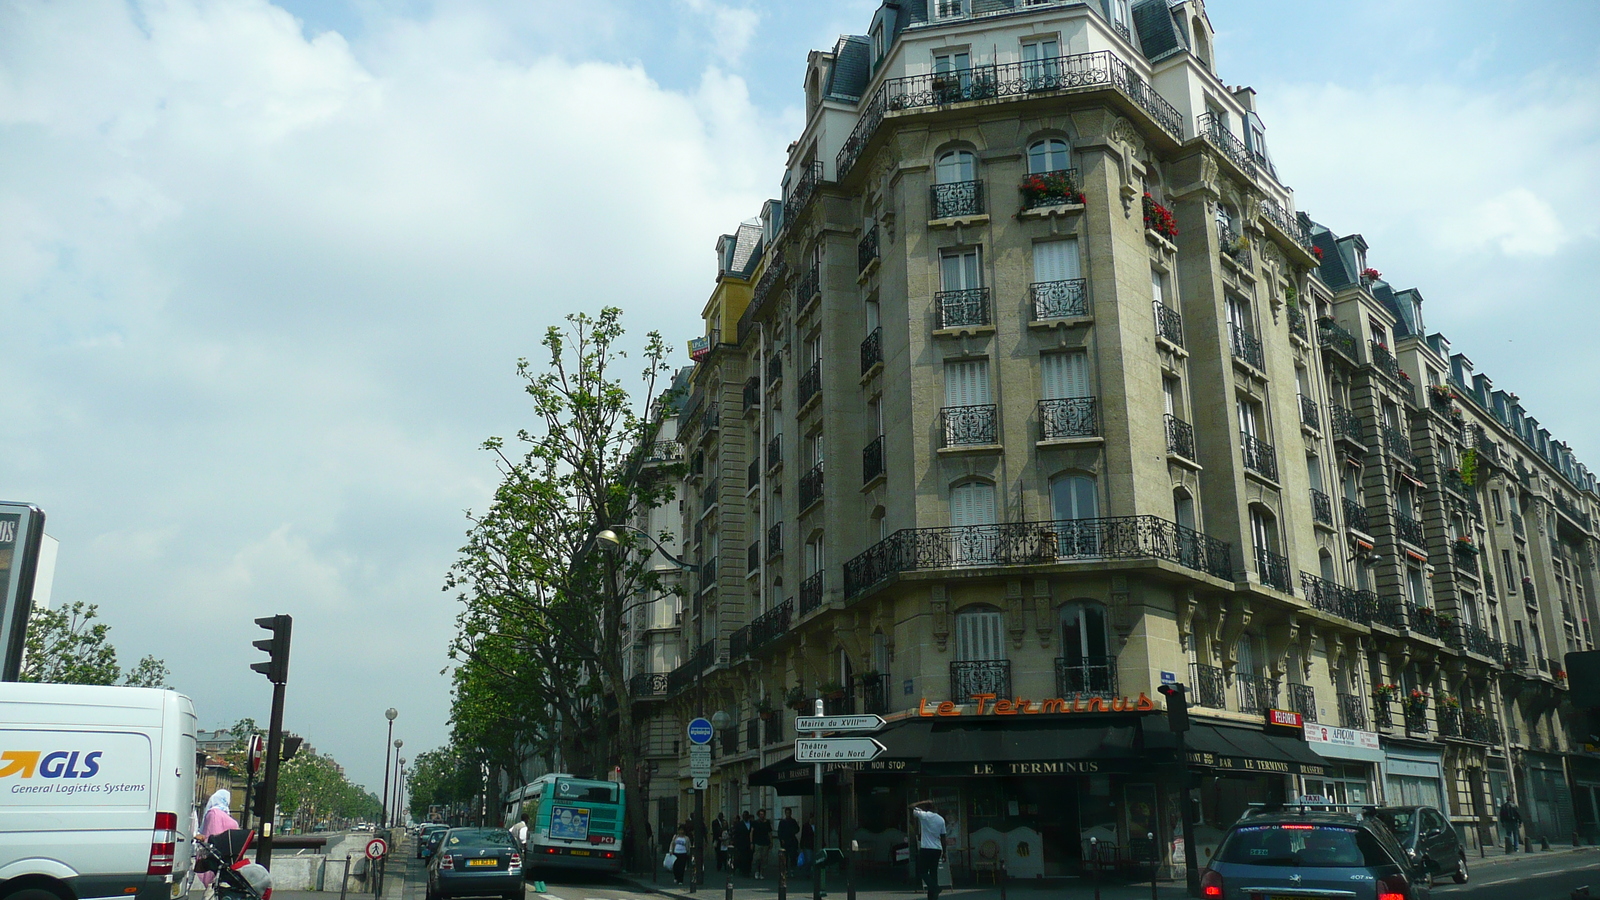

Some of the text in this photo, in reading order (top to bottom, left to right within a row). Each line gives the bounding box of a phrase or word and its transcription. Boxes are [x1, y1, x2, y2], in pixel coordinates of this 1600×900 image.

[919, 692, 1154, 717] Le Terminus
[800, 720, 825, 728] Mairie
[828, 719, 837, 727] du
[1275, 710, 1297, 725] PELFORTH
[800, 742, 828, 750] Théâtre
[834, 750, 844, 758] du
[847, 750, 866, 758] Nord
[39, 751, 103, 779] GLS
[871, 761, 885, 770] NON
[888, 761, 906, 770] STOP
[974, 761, 1099, 775] LE TERMINUS
[1219, 758, 1324, 775] BAR LE TERMINUS BRASSERIE
[11, 782, 146, 796] General Logistics Systems
